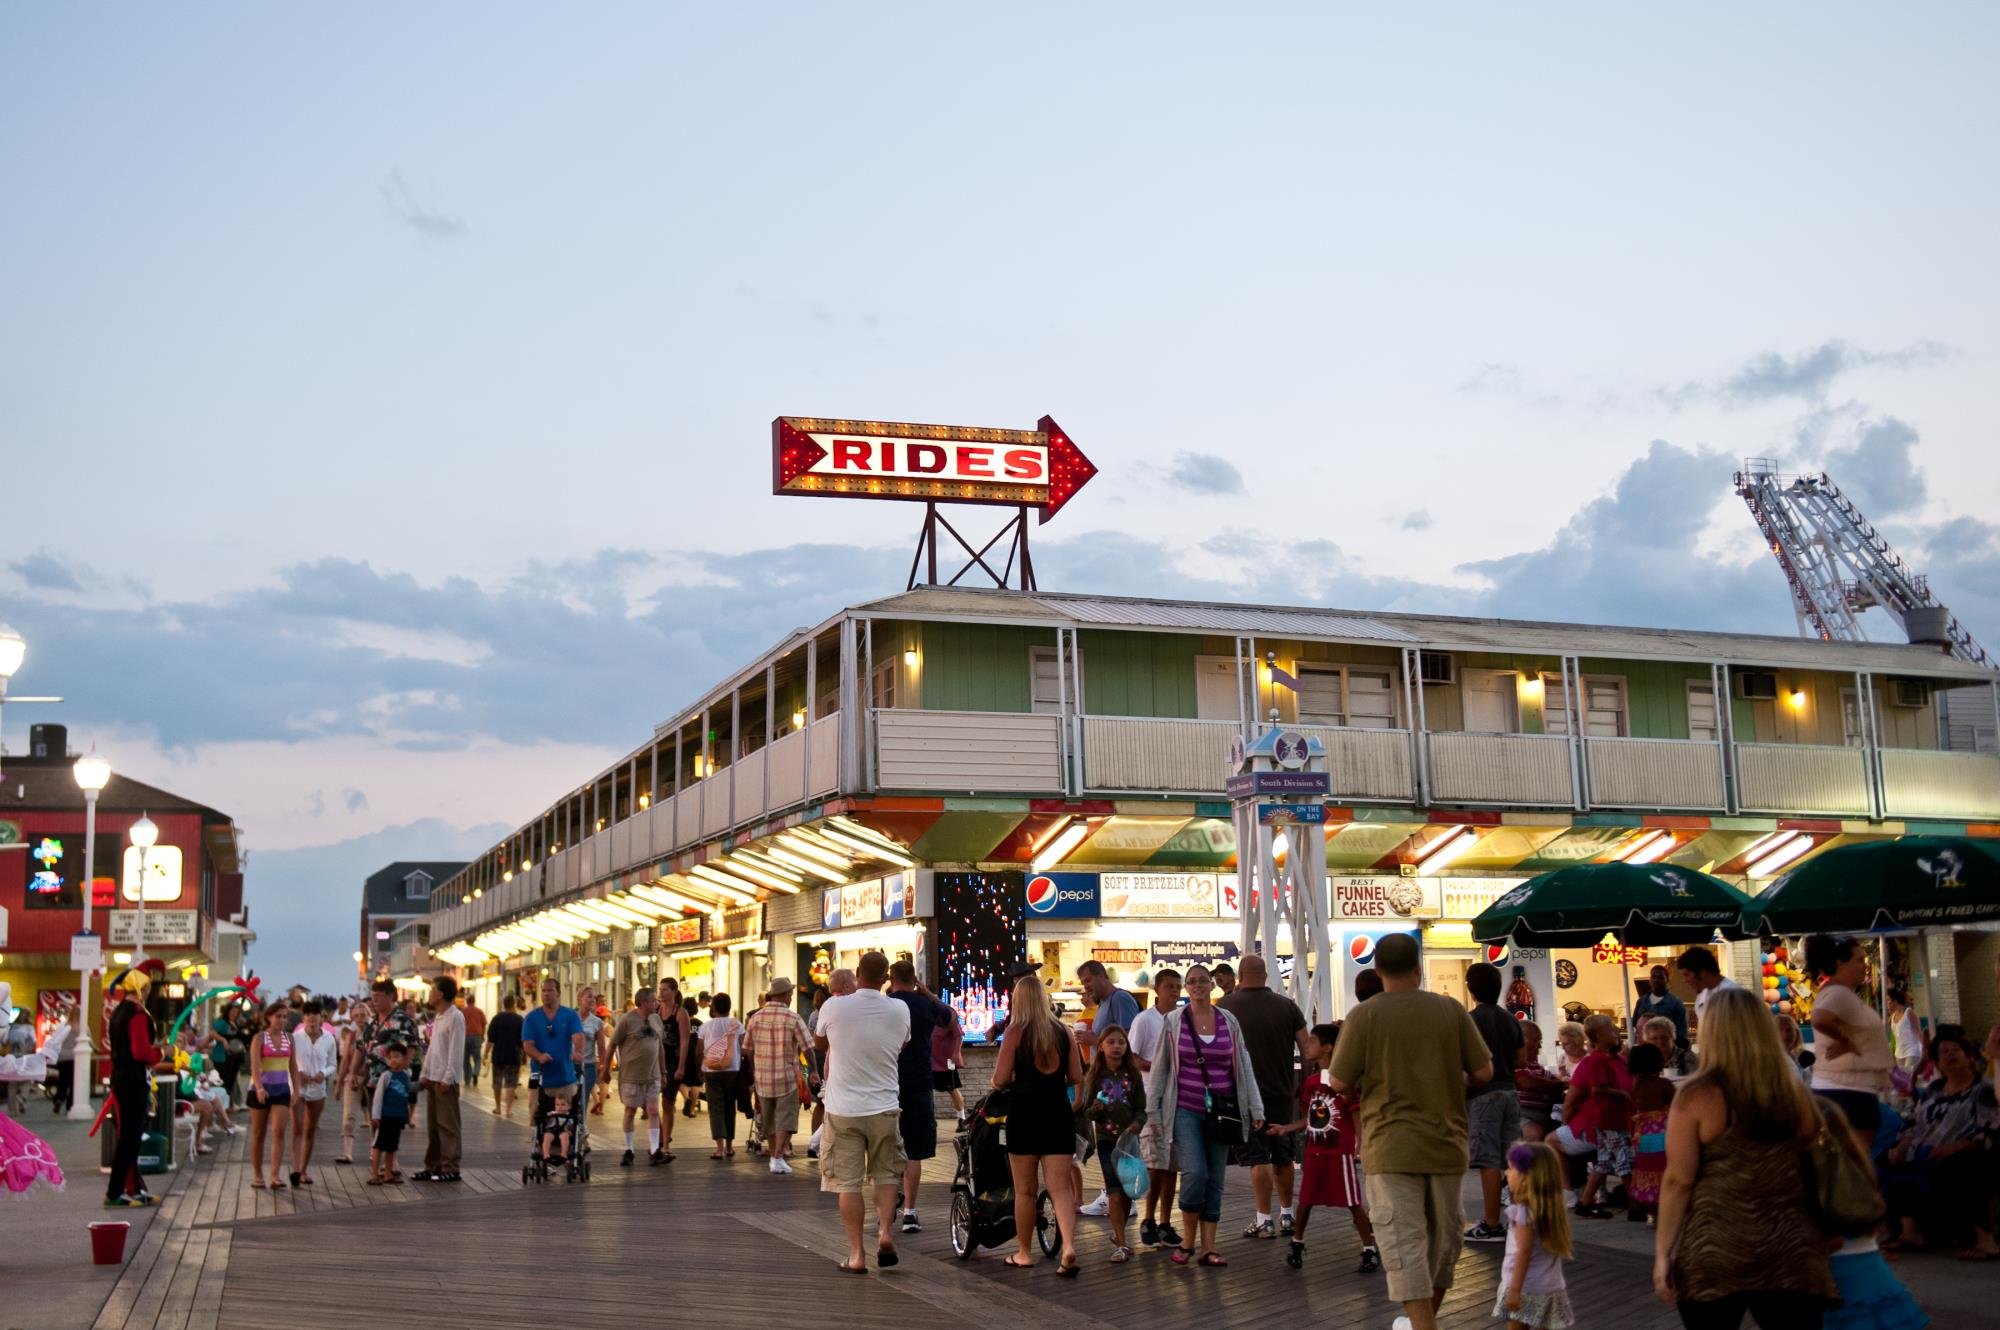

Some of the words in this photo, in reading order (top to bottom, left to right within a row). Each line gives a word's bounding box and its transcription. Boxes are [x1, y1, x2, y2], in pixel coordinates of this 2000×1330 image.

[832, 439, 1043, 479] RIDES
[1260, 778, 1281, 787] South
[1283, 779, 1314, 787] Division
[1315, 779, 1326, 787] St.
[1266, 807, 1295, 819] SUNSET
[1307, 805, 1320, 813] THE
[1104, 876, 1129, 889] SOFT
[1133, 877, 1186, 890] PRETZELS
[1058, 888, 1094, 902] pepsi
[1336, 886, 1391, 901] FUNNEL
[1127, 903, 1169, 915] CORN
[1172, 903, 1214, 915] DOGS
[1342, 901, 1386, 916] CAKES
[1945, 904, 1974, 917] FRIED
[1153, 943, 1171, 955] Funnel
[1170, 943, 1187, 955] Cakes
[1512, 949, 1547, 961] pepsi
[1596, 950, 1644, 966] CAKES
